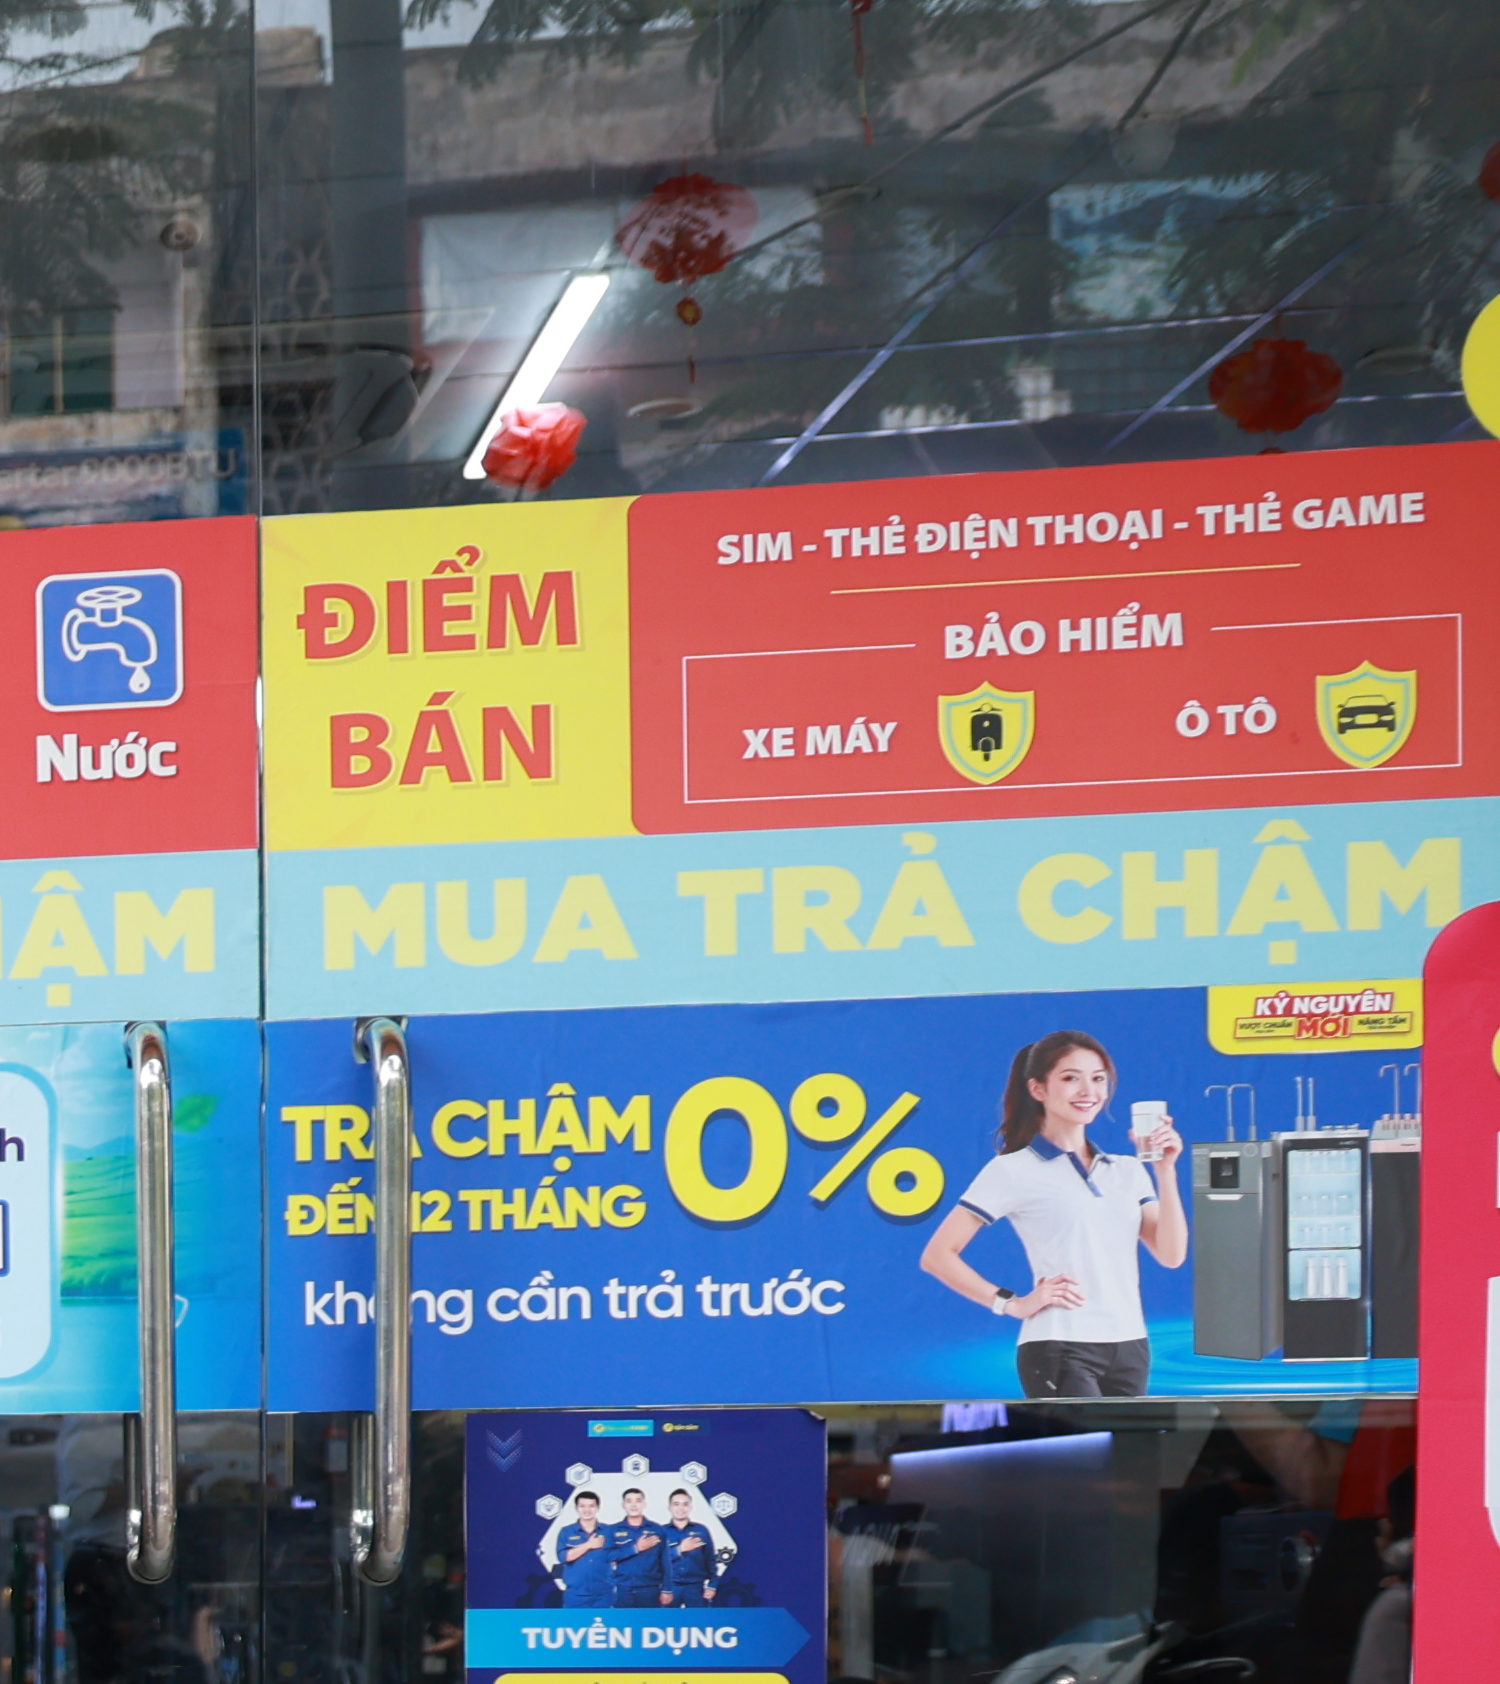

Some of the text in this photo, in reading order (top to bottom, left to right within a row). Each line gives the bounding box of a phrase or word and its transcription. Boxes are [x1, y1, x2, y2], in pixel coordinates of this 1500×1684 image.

[717, 490, 1425, 566] SIM THẺ ĐIỆN THOẠI THẺ GAME
[297, 543, 578, 661] ĐIỂM
[943, 604, 1184, 661] BẢO HIỂM
[328, 690, 556, 792] BÁN
[742, 715, 898, 761] XE MÁY
[1175, 696, 1277, 739] Ô TÔ
[36, 731, 178, 784] Nước
[322, 818, 1463, 972] MUA TRẢ CHẬM
[1256, 990, 1392, 1015] KỶ NGUYÊN
[1298, 1014, 1350, 1039] MỚI
[431, 1080, 652, 1185] CHẬM
[662, 1071, 946, 1225] 0%
[465, 1181, 648, 1235] THÁNG
[487, 1267, 847, 1322] cần trả trước
[522, 1616, 739, 1656] TUYỂN DỤNG
